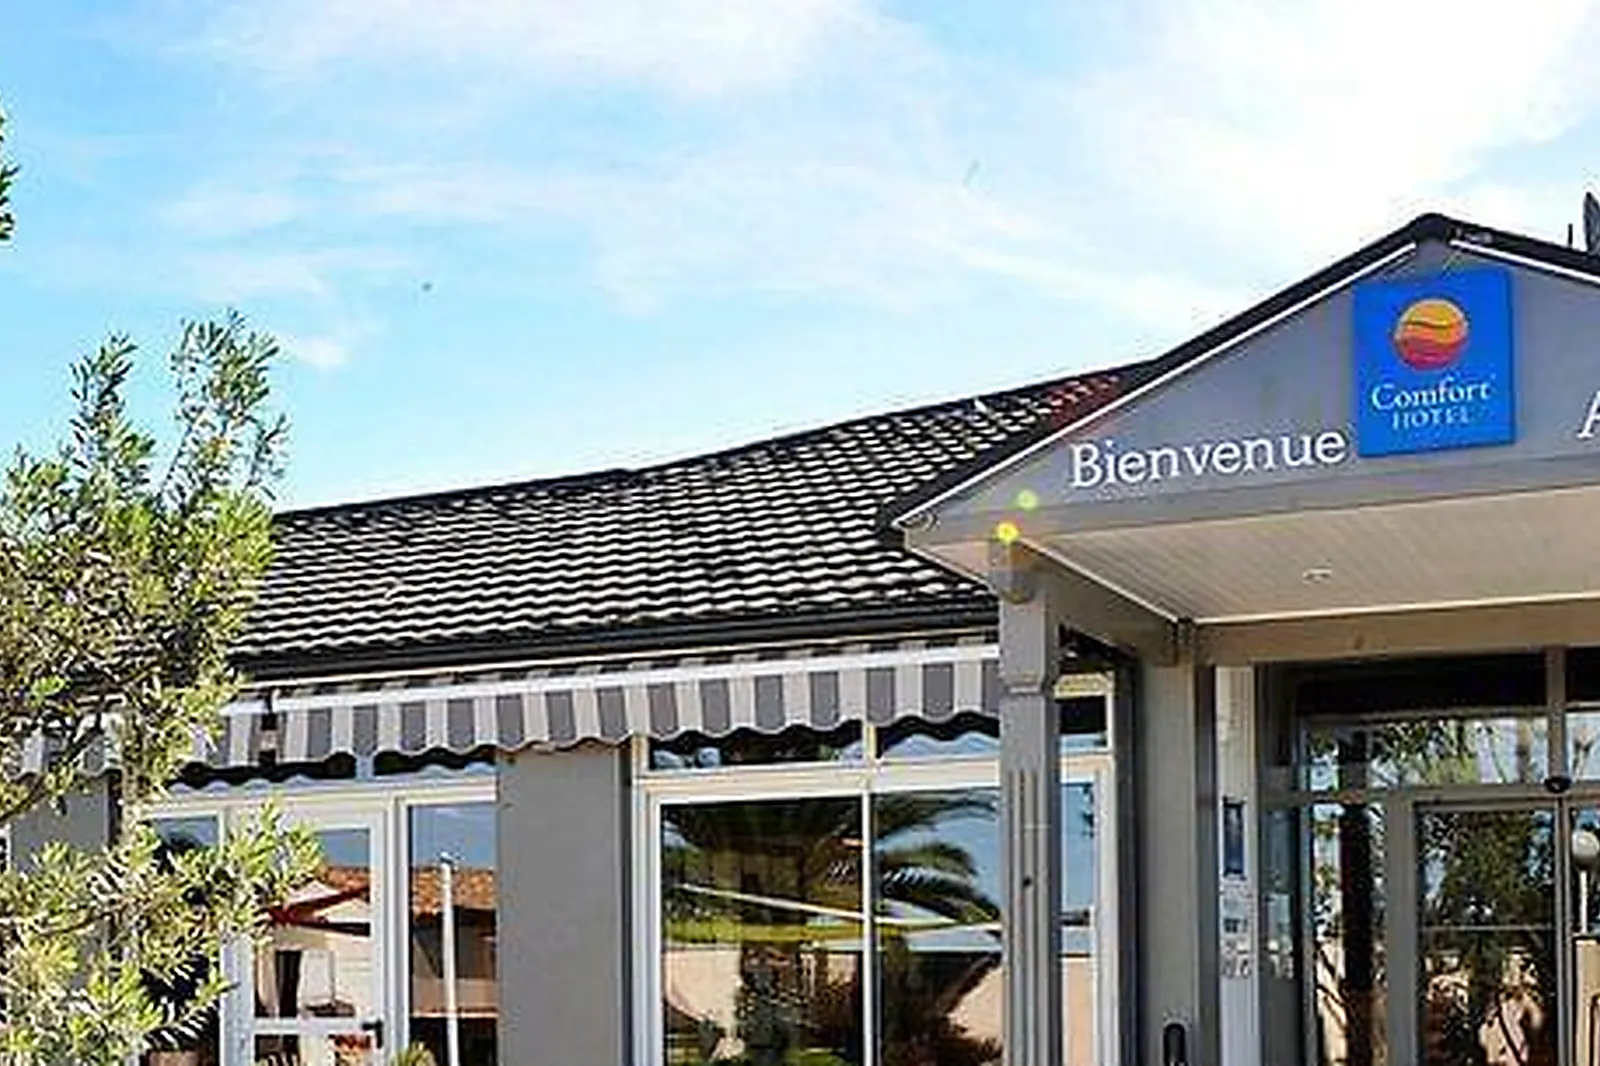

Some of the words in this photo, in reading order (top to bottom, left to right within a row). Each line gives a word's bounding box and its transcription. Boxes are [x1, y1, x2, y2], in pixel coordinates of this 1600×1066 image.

[1371, 375, 1490, 410] Comfort
[1391, 404, 1469, 430] HOTEL
[1070, 430, 1346, 487] Bienvenue
